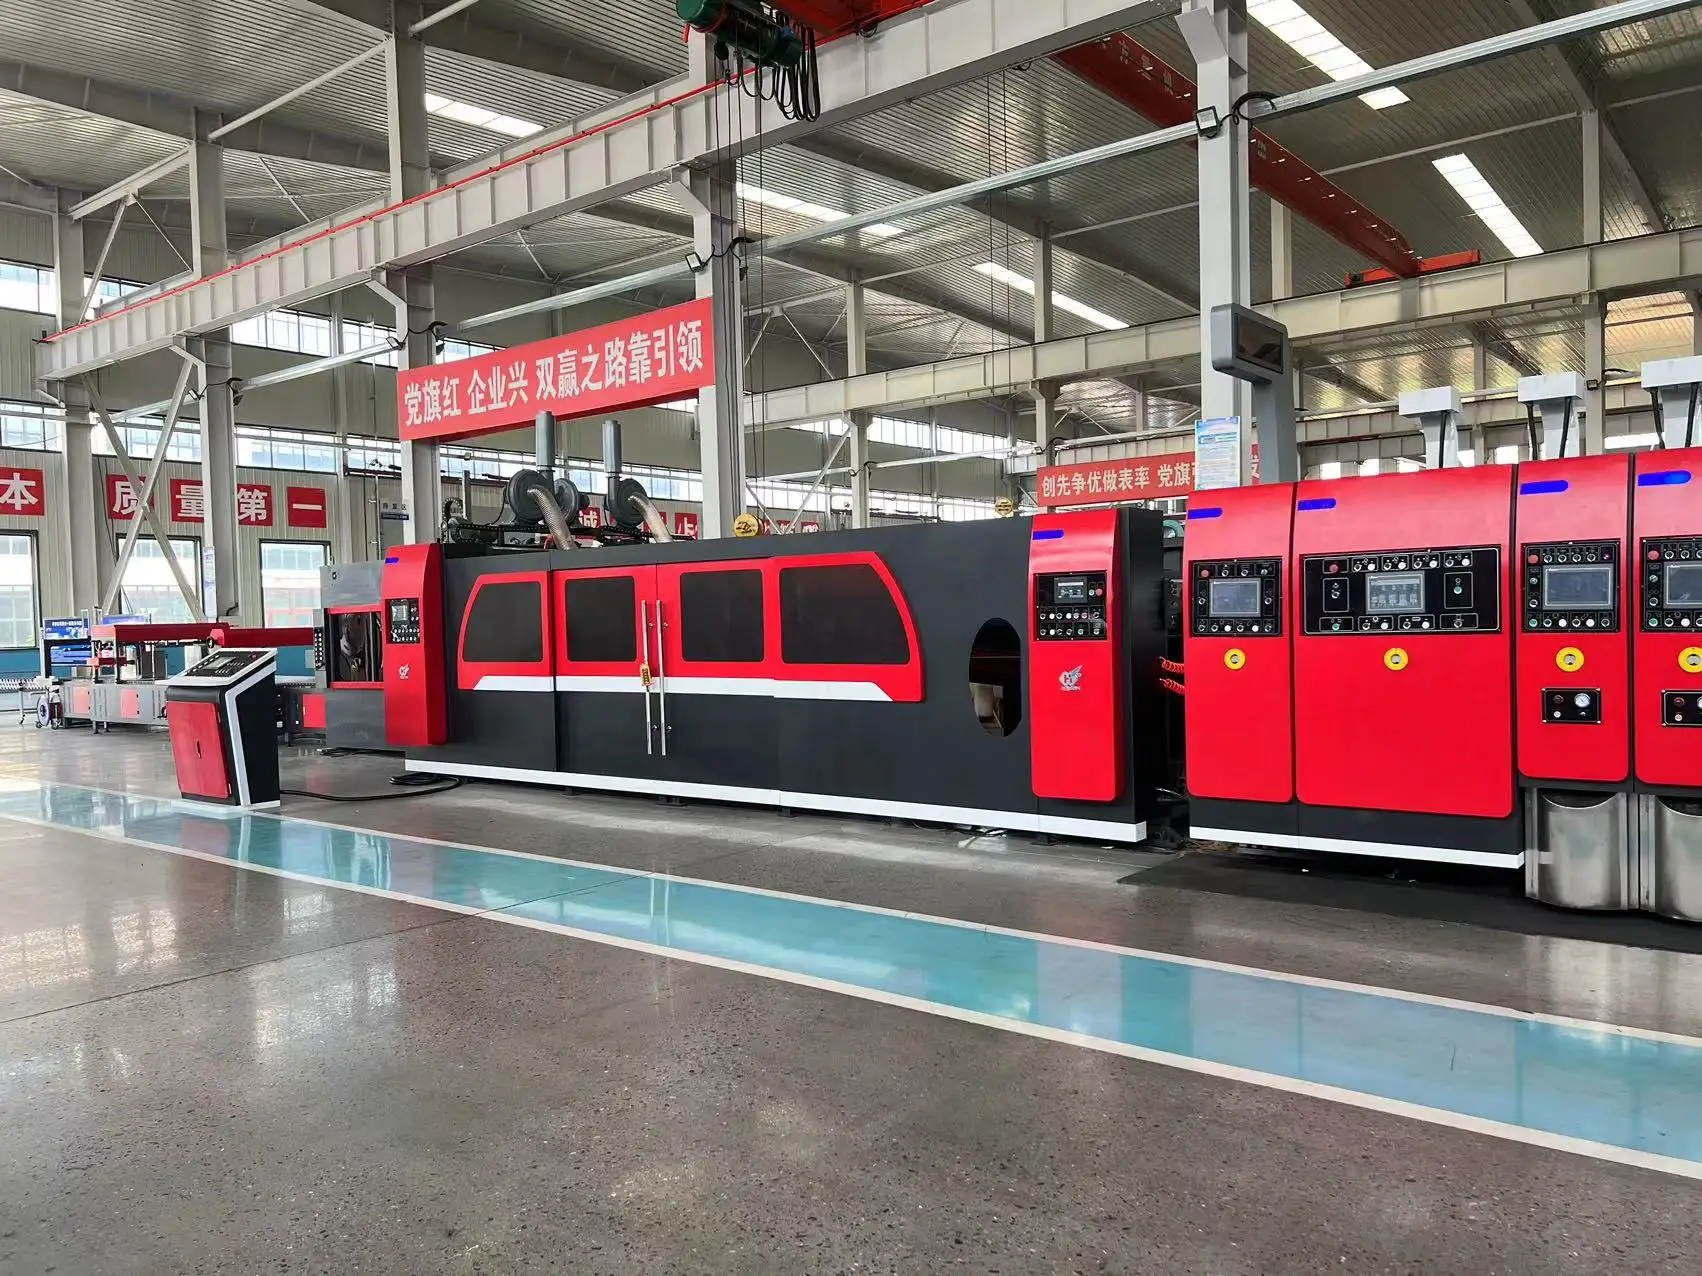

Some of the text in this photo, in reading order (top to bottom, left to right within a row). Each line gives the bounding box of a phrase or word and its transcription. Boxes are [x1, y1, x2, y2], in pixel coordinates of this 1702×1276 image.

[404, 319, 704, 427] 党旗红 企业兴 双赢之路靠引领
[0, 472, 39, 511] 本
[1042, 461, 1195, 498] 创先争优做表率 党旗
